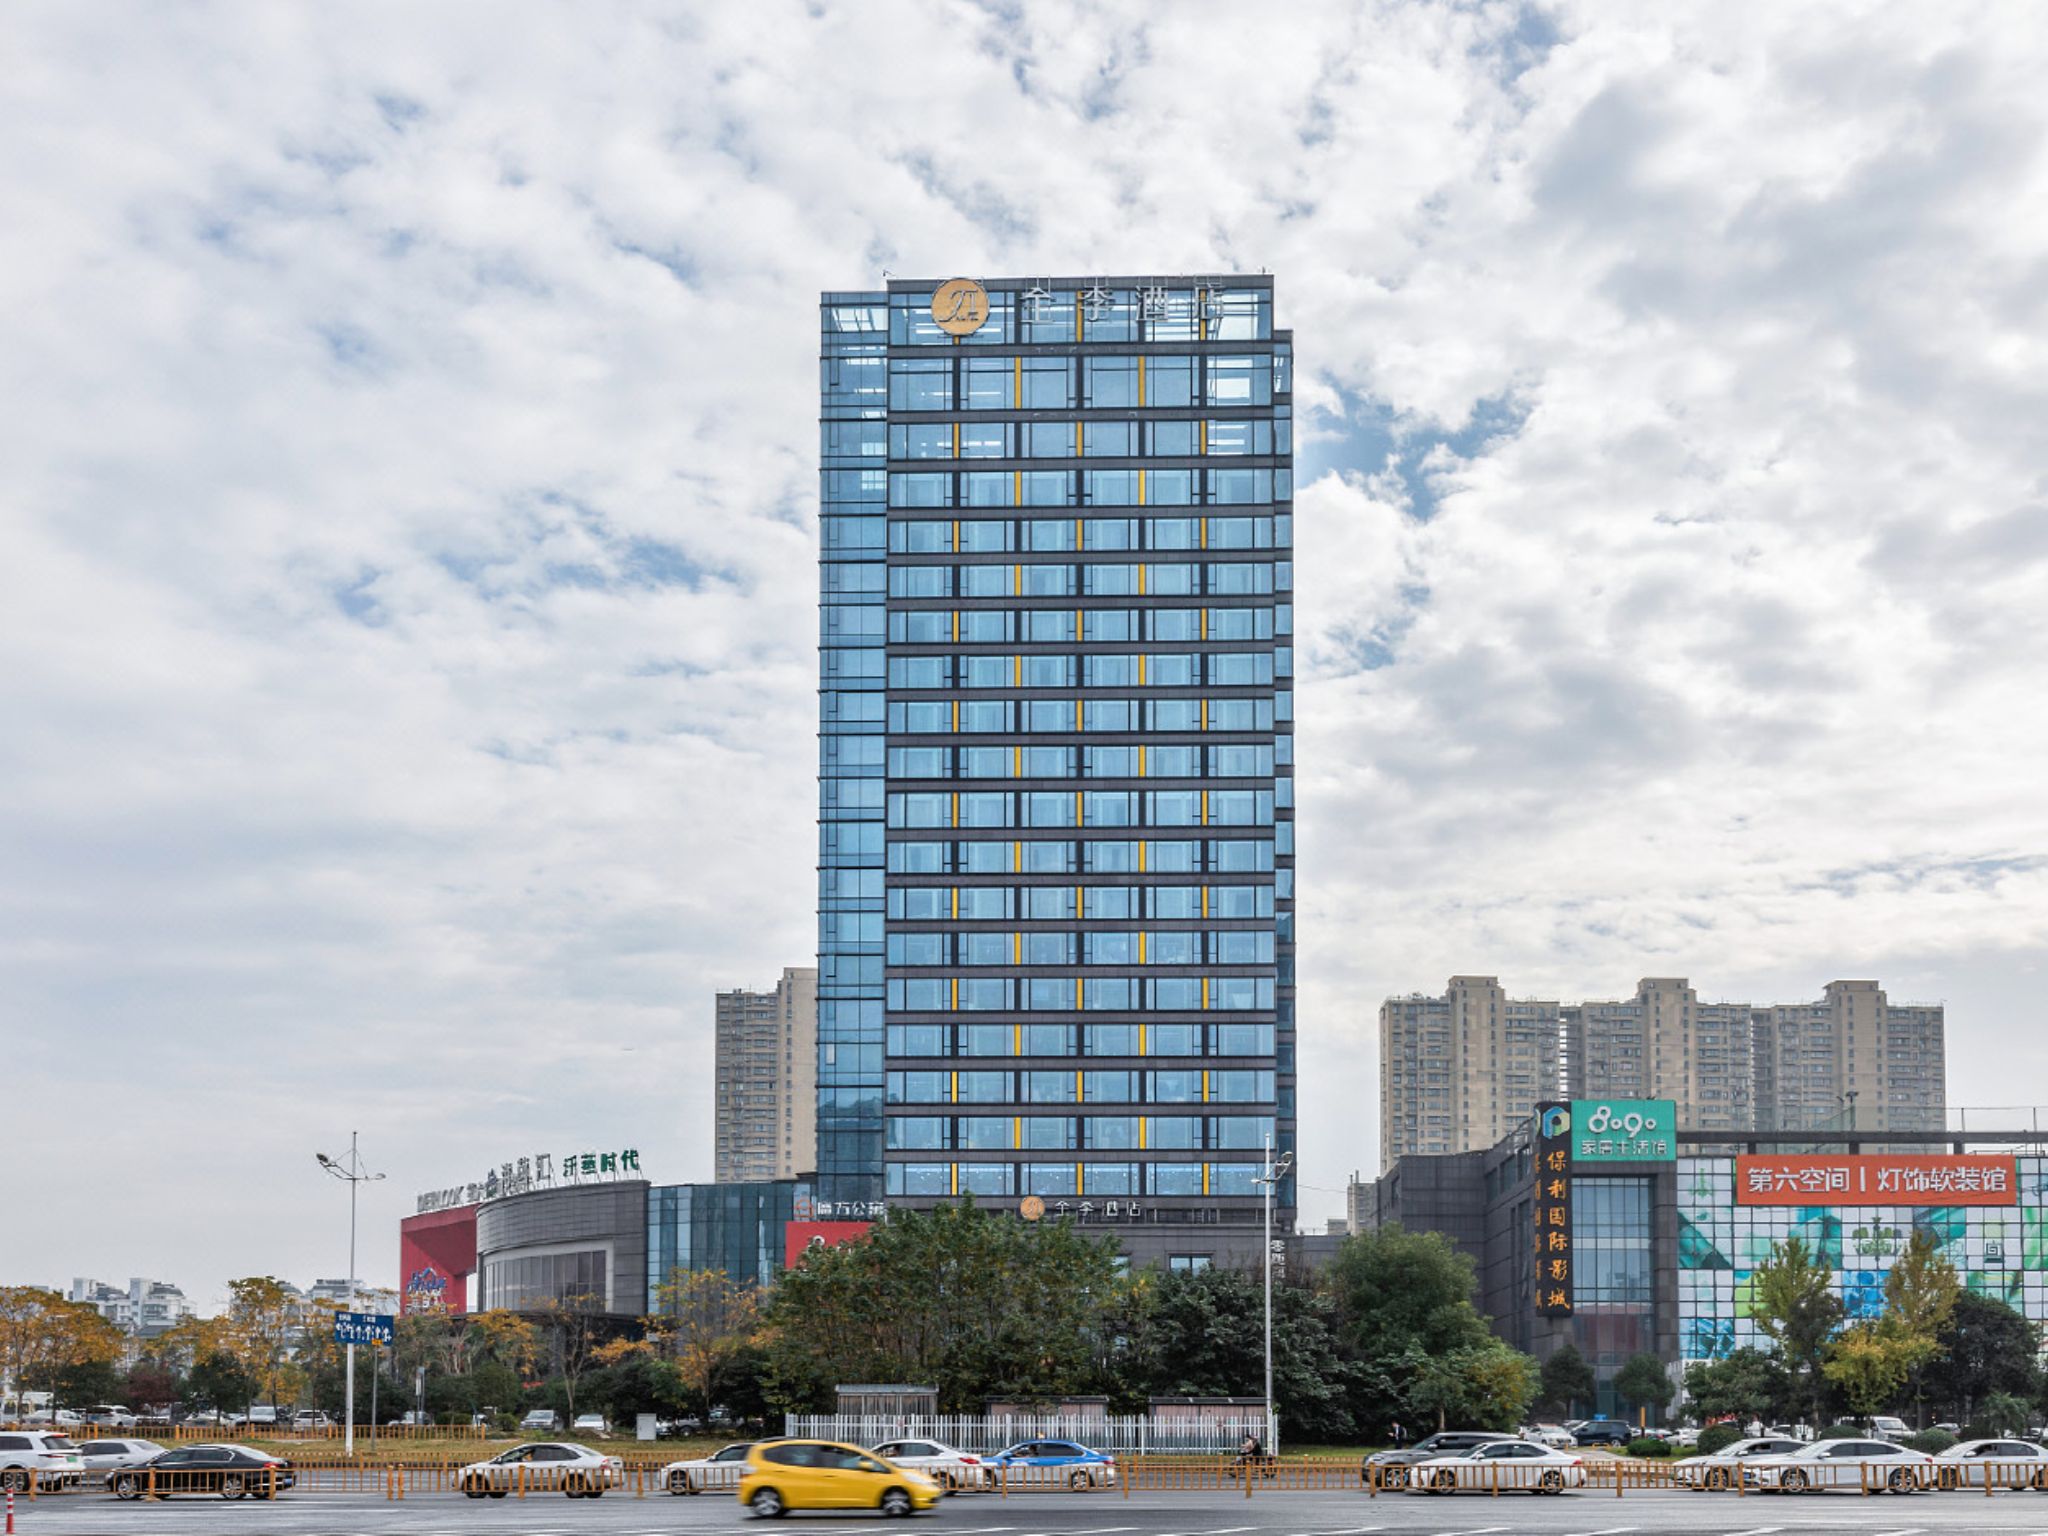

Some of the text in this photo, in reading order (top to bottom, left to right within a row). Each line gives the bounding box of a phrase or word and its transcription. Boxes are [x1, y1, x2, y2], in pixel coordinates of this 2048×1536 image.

[1021, 285, 1224, 322] 全季酒店
[1588, 1106, 1657, 1138] 8090
[563, 1150, 640, 1178] 汗蒸时代
[1748, 1166, 2007, 1193] 第六空间 灯饰软装馆
[1054, 1200, 1141, 1217] 全季酒店
[1547, 1150, 1571, 1310] 保利国际影城
